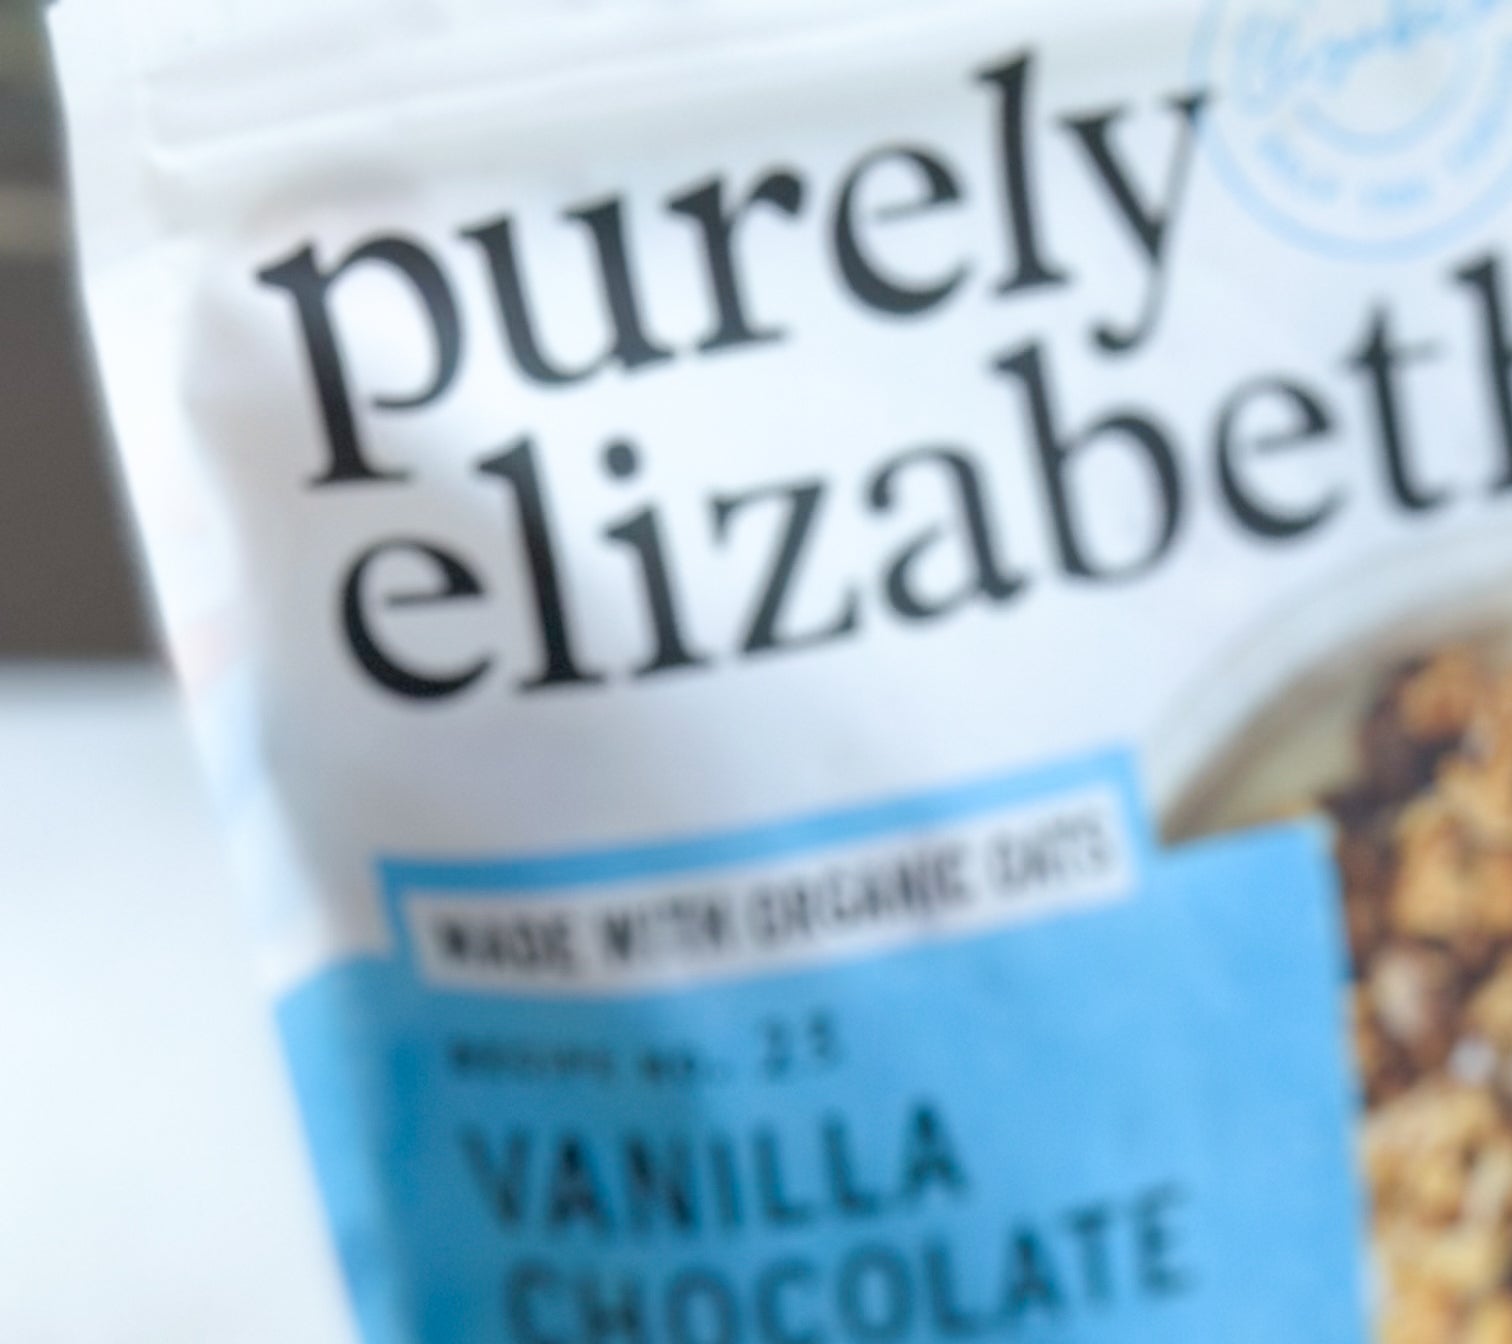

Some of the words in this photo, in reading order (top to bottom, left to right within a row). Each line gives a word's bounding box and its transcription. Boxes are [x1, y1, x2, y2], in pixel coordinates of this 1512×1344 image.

[255, 48, 1214, 490] purely
[437, 909, 578, 980] MADE
[599, 893, 734, 966] WITH
[747, 838, 974, 946] ORGANIC
[984, 808, 1112, 890] OATS
[461, 1098, 968, 1236] VANILLA
